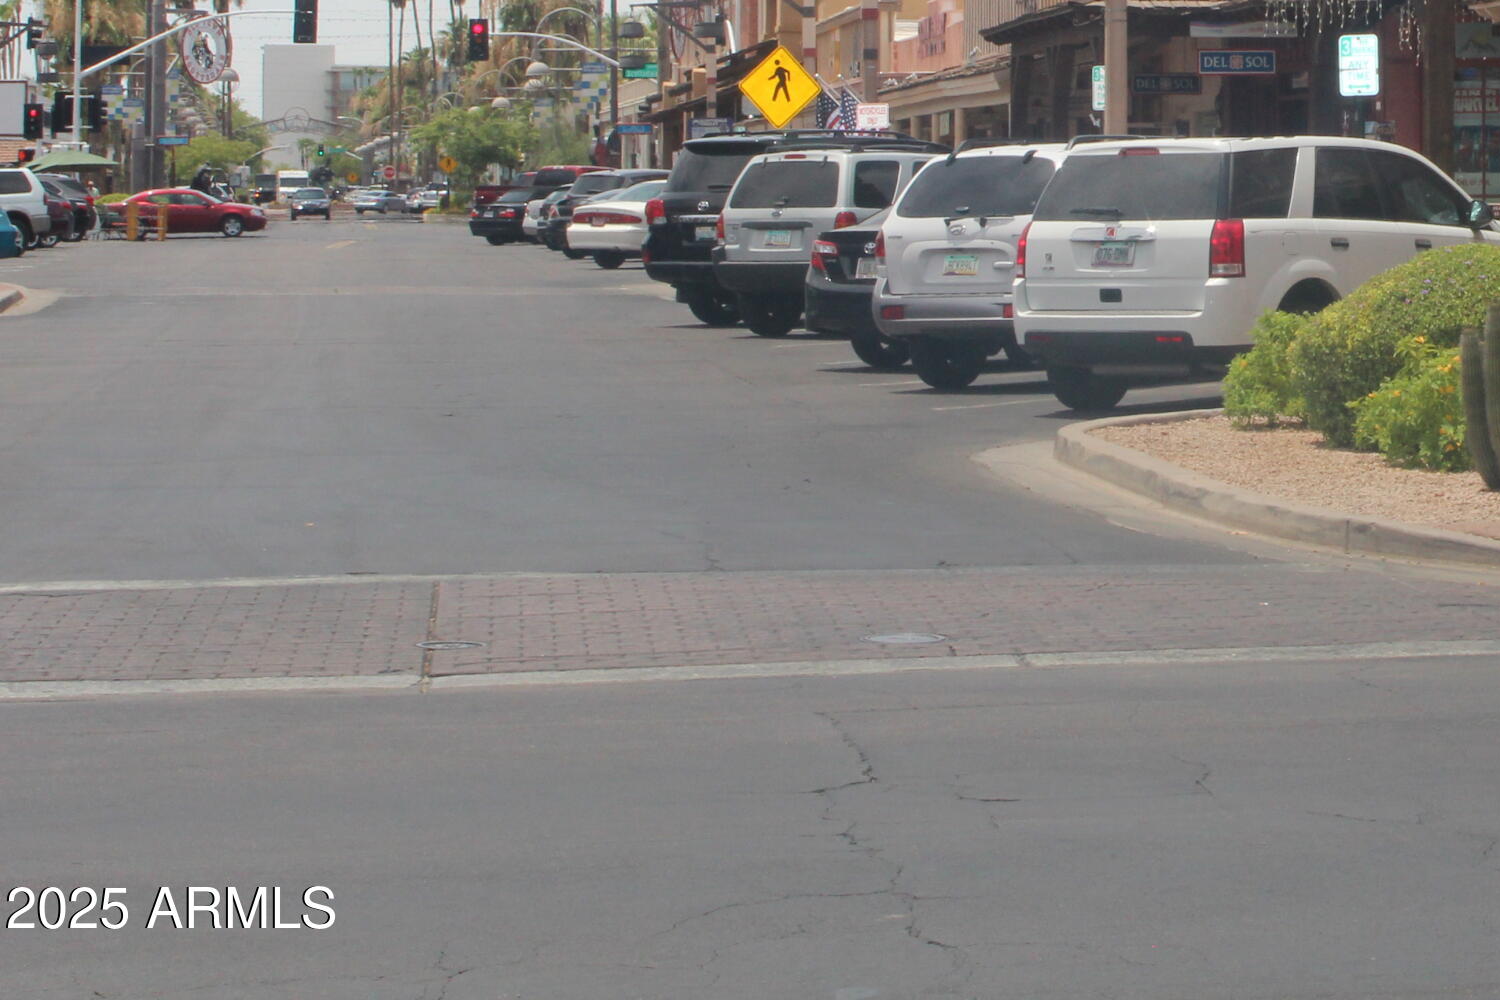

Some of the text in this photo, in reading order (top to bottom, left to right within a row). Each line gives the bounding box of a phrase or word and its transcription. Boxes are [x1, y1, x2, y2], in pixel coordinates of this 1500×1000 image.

[1342, 40, 1351, 55] 3
[1203, 56, 1270, 68] DEL SOL
[1349, 60, 1369, 69] ANY
[1348, 72, 1370, 80] TIME
[1136, 79, 1194, 90] DEL SOL
